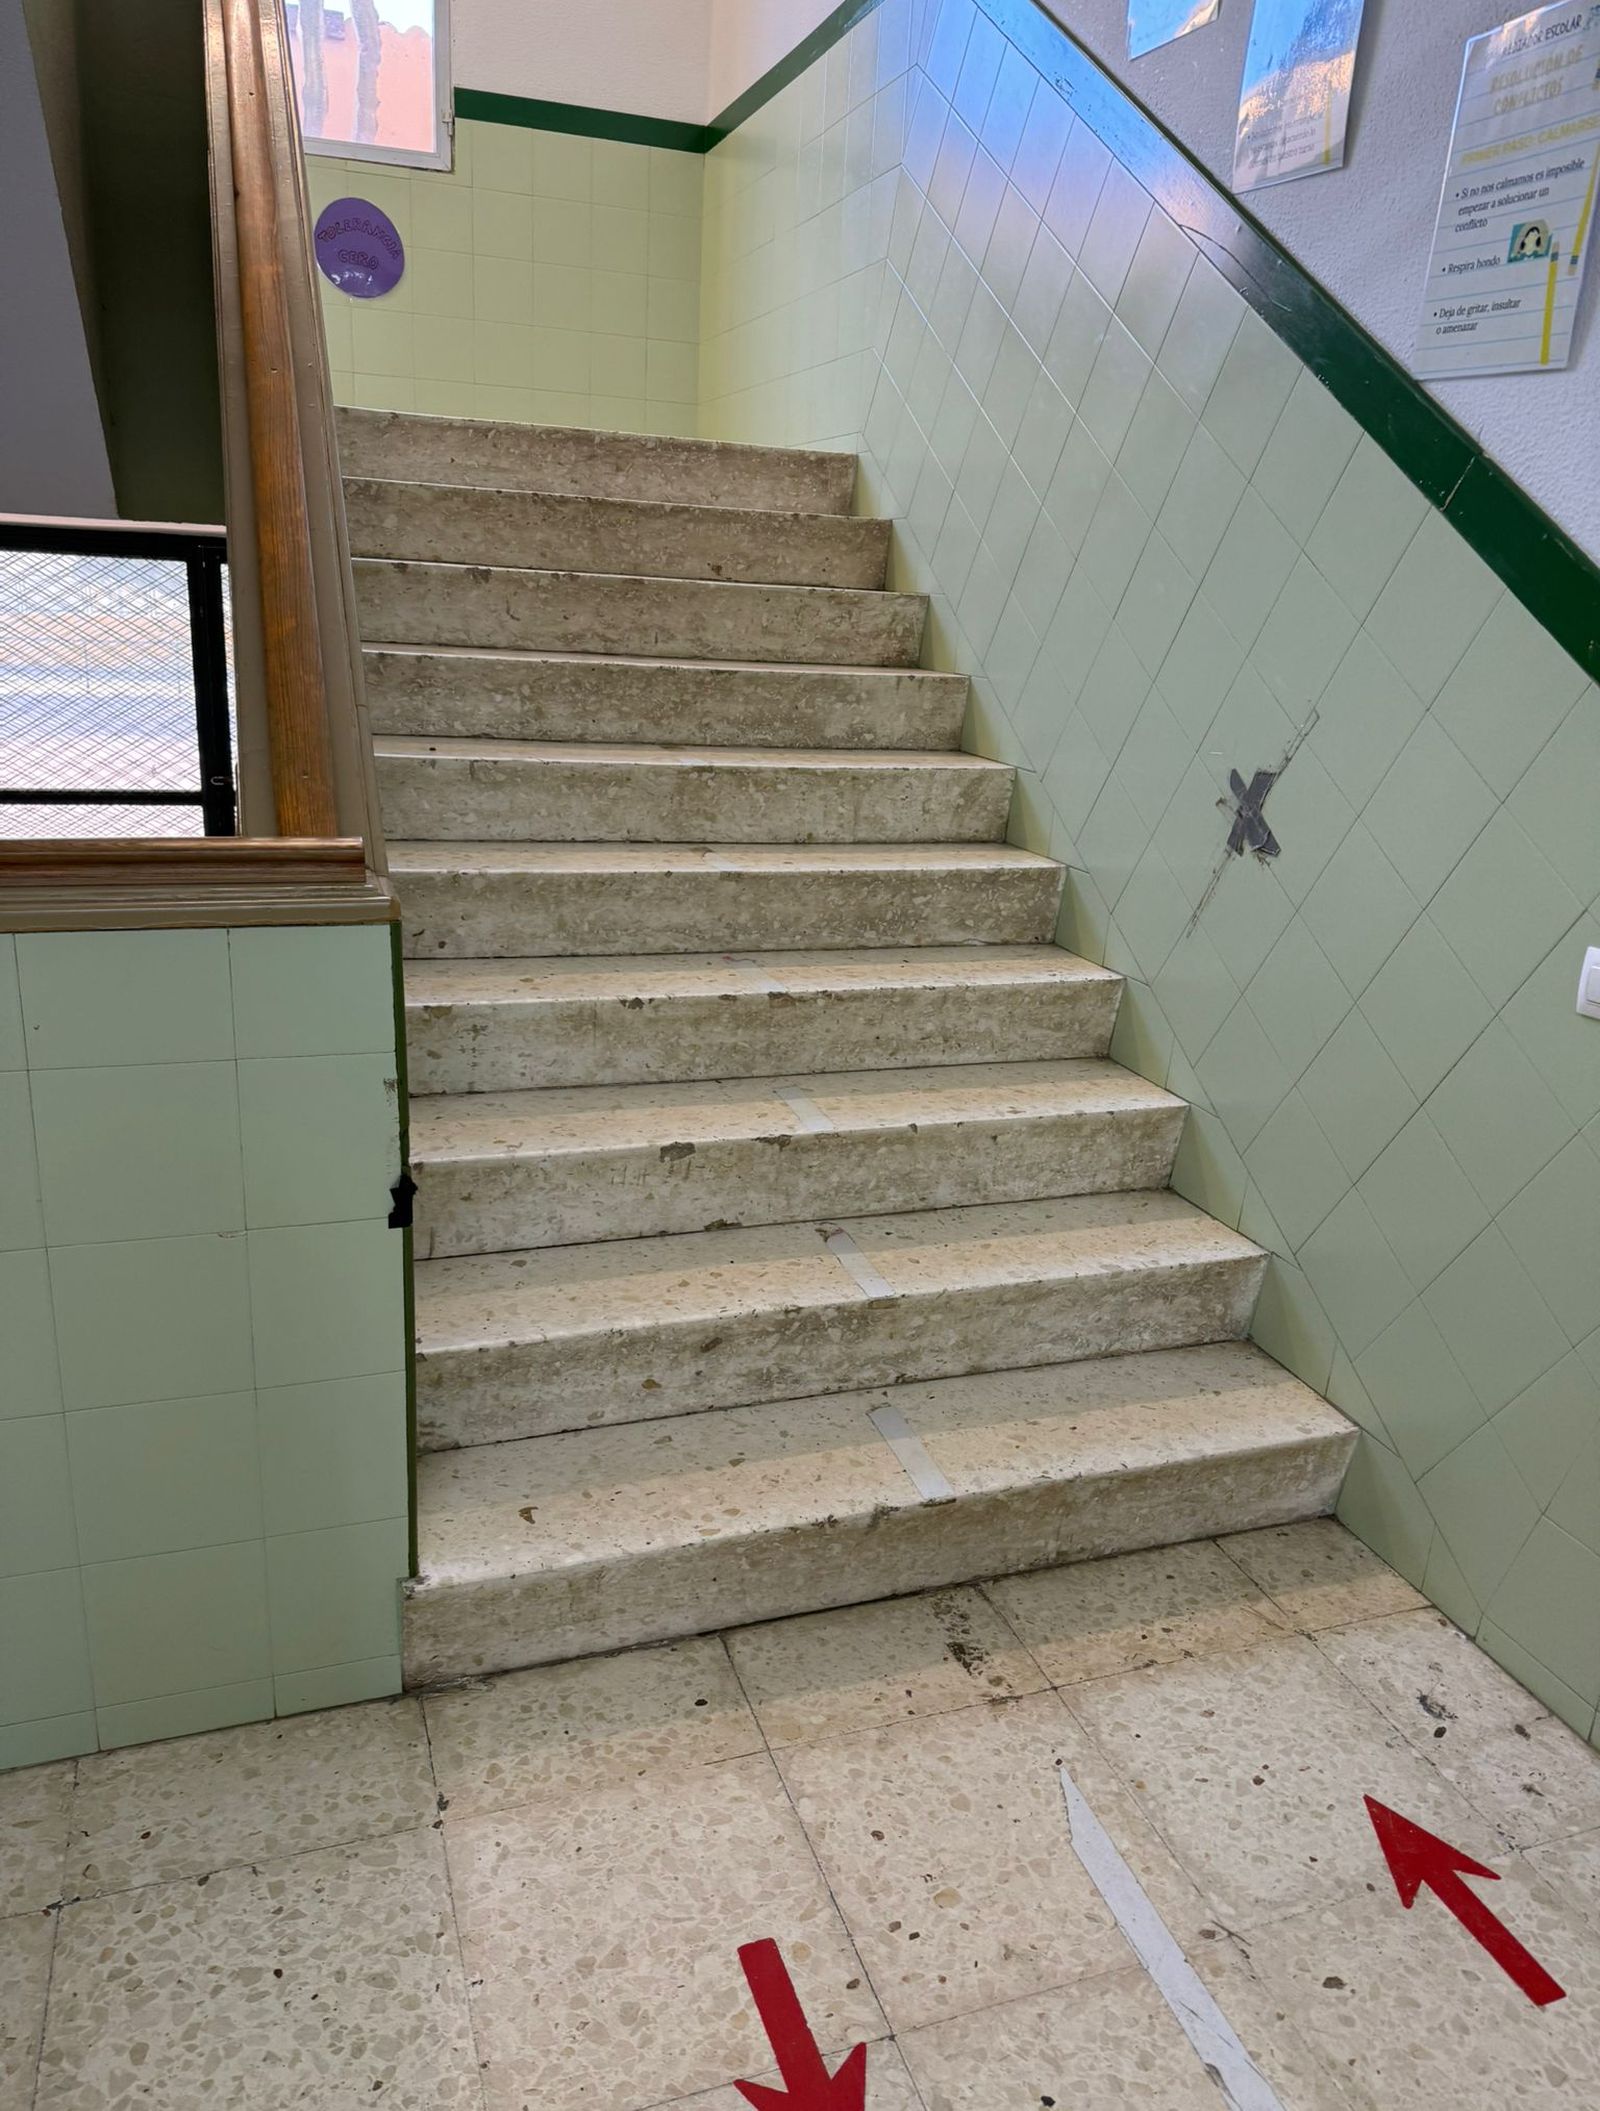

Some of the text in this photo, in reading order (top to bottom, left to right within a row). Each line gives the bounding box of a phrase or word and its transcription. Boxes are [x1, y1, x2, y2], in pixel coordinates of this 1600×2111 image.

[1545, 14, 1582, 40] ESCOLAR
[1470, 187, 1480, 197] no
[1481, 183, 1495, 195] nos
[1495, 173, 1534, 191] calmamos
[1535, 170, 1545, 181] es
[1546, 158, 1585, 179] imposible
[1458, 201, 1490, 216] empezar
[1497, 190, 1538, 207] solucionar
[1538, 187, 1549, 197] un
[1455, 218, 1488, 232] conflicto
[317, 217, 401, 260] TOLERANCIA
[338, 249, 379, 270] CERO
[1447, 255, 1501, 274] Respira hondo
[1439, 298, 1521, 320] Deja de gritar, insultar
[1442, 322, 1478, 334] amenazar
